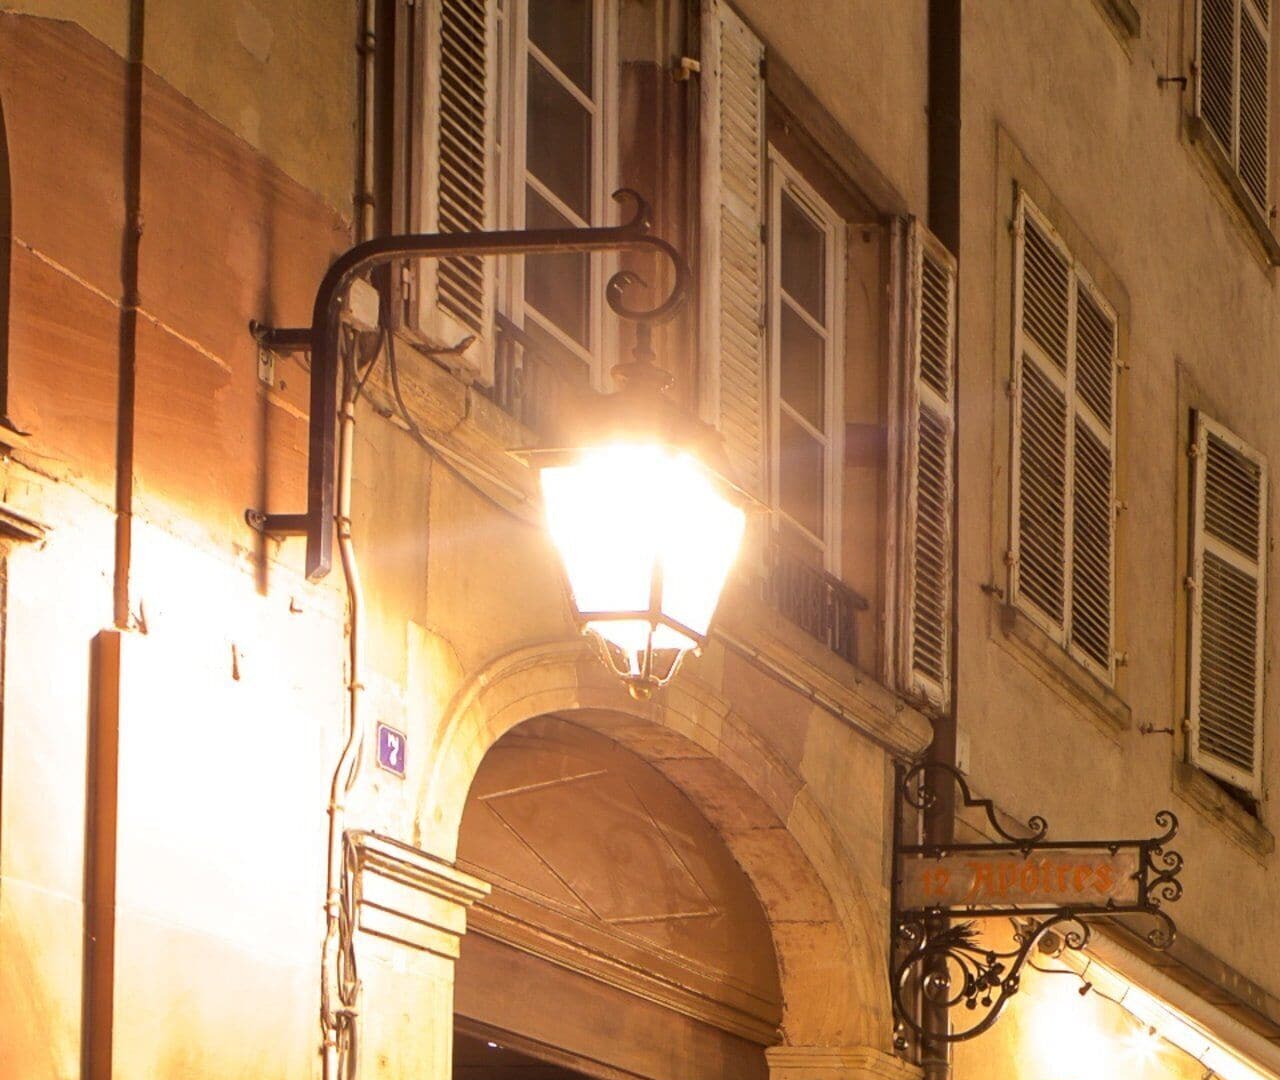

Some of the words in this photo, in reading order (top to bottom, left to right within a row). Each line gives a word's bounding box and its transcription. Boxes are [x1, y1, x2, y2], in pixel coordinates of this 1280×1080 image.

[387, 731, 400, 767] 7
[922, 866, 949, 896] 12
[965, 857, 1115, 900] Apôtres
